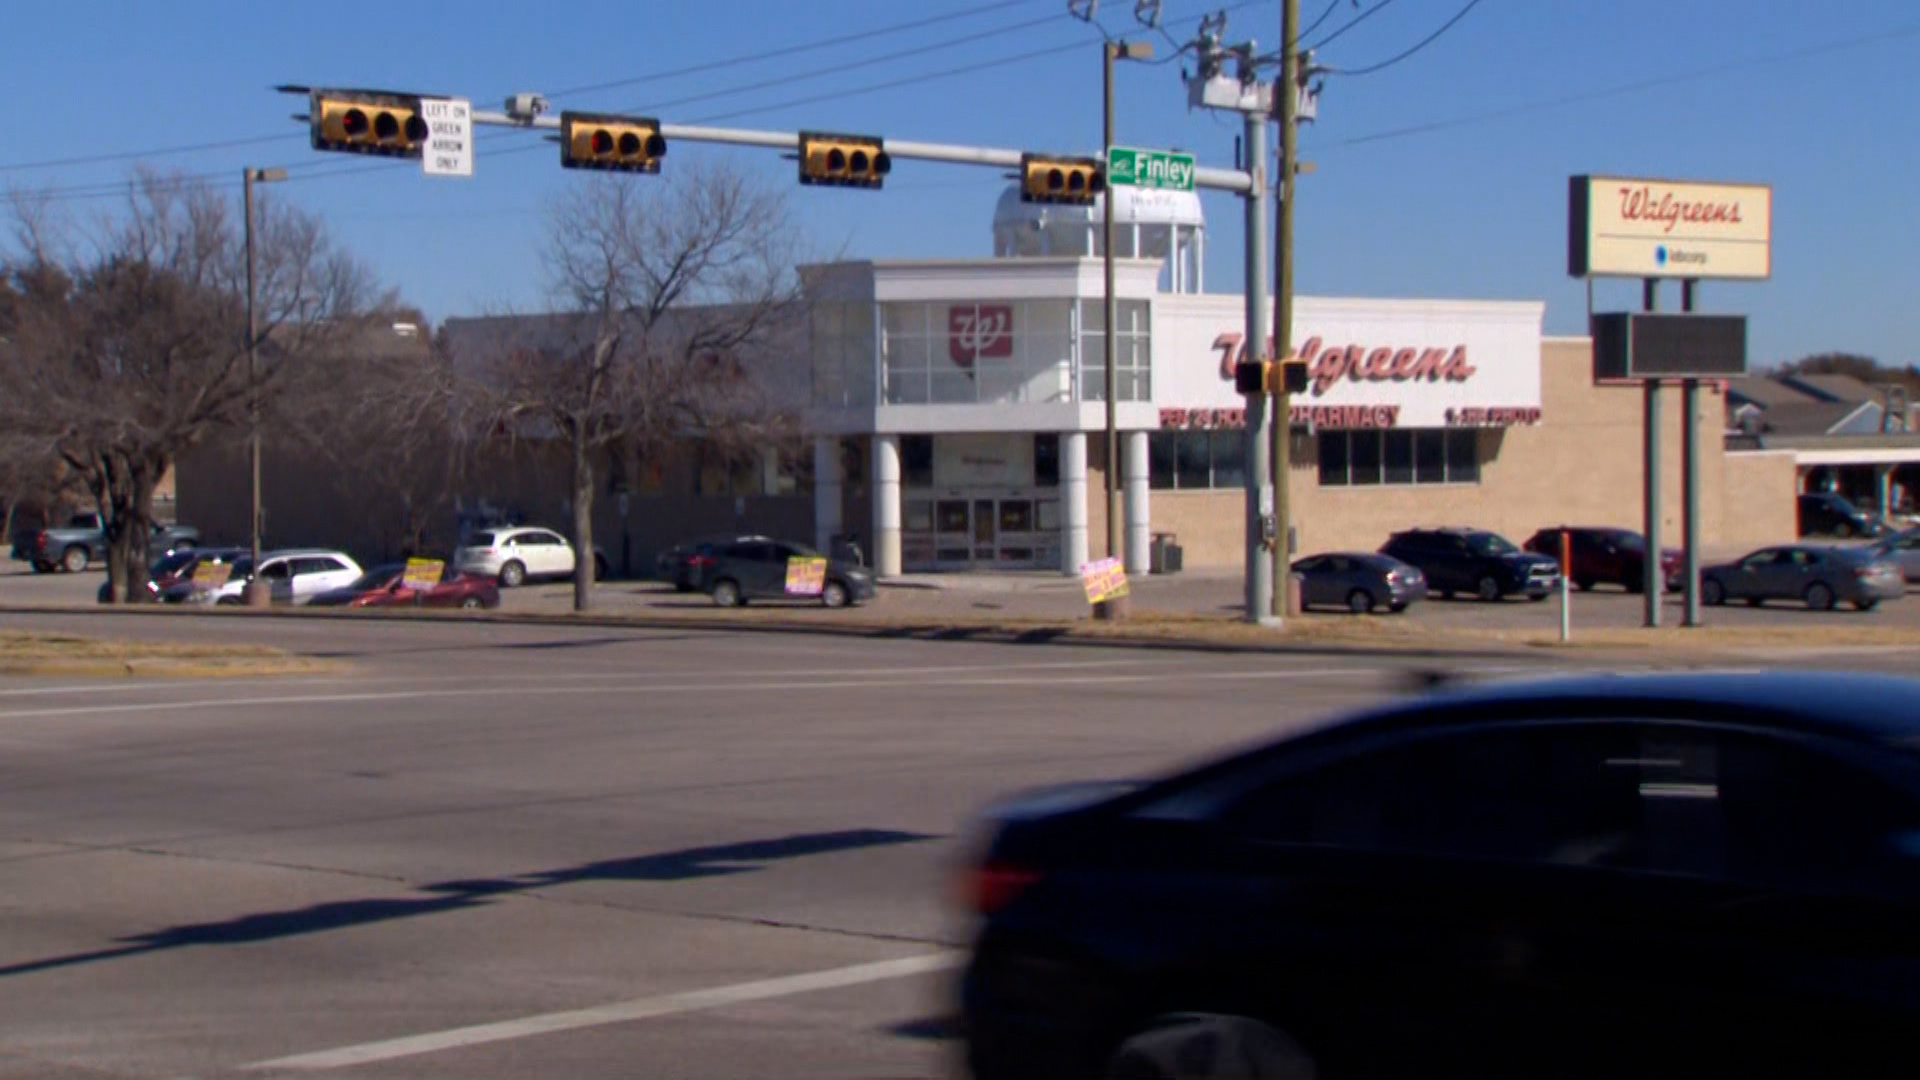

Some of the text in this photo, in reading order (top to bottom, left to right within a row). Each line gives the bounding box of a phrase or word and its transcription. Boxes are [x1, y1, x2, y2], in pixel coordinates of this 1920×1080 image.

[426, 103, 448, 117] LEFT
[432, 121, 462, 135] GREEN
[432, 139, 463, 152] ARROW
[435, 155, 459, 169] ONLY
[1134, 153, 1193, 186] Finley
[1618, 187, 1742, 234] Walgreens
[1212, 333, 1476, 398] Wlgreens
